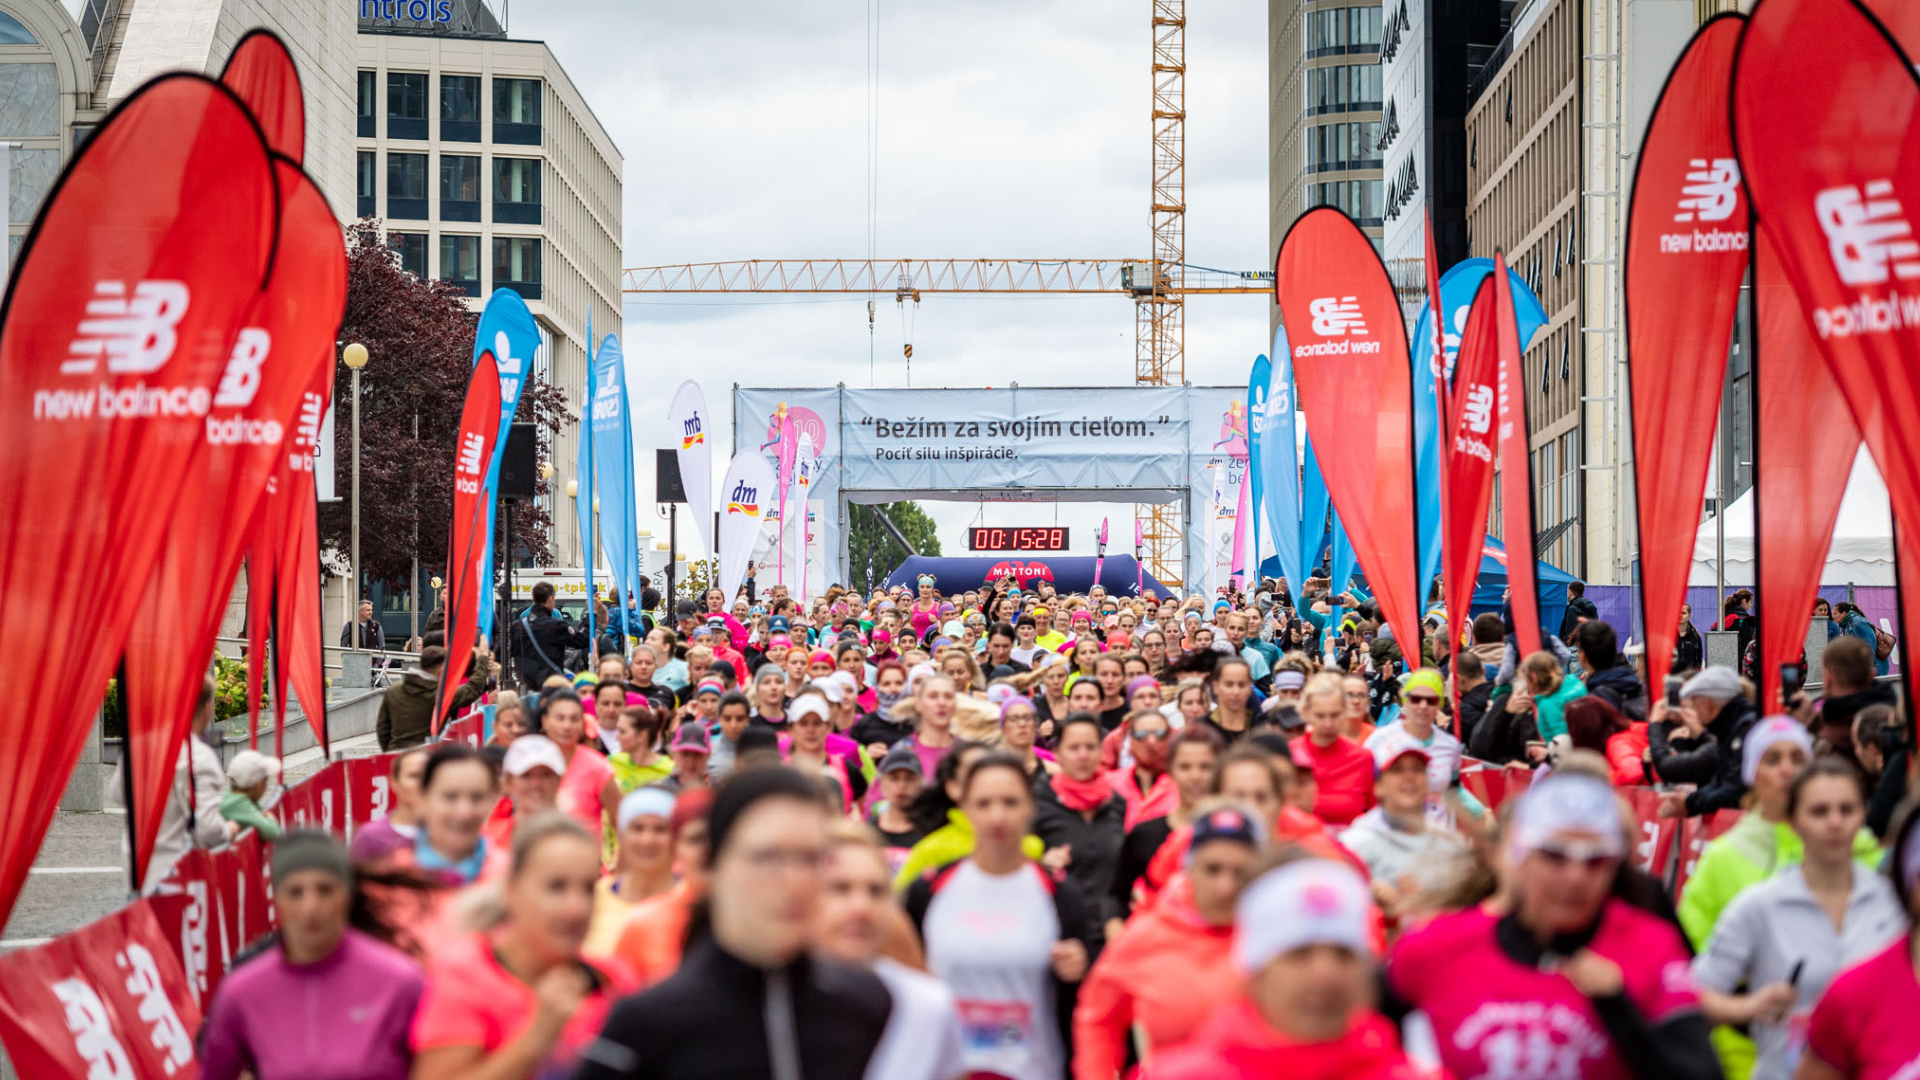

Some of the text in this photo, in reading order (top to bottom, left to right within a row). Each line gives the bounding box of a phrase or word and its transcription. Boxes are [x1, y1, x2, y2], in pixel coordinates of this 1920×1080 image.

[1660, 232, 1693, 253] new
[33, 389, 95, 420] new
[862, 415, 1169, 442] “Bežím za svojím cieľom.”
[876, 445, 1018, 463] Pocíť silu inšpirácie.
[731, 479, 758, 504] dm
[1219, 506, 1235, 516] dm
[974, 529, 1063, 549] 00:15:28
[993, 567, 1046, 576] MATTONI
